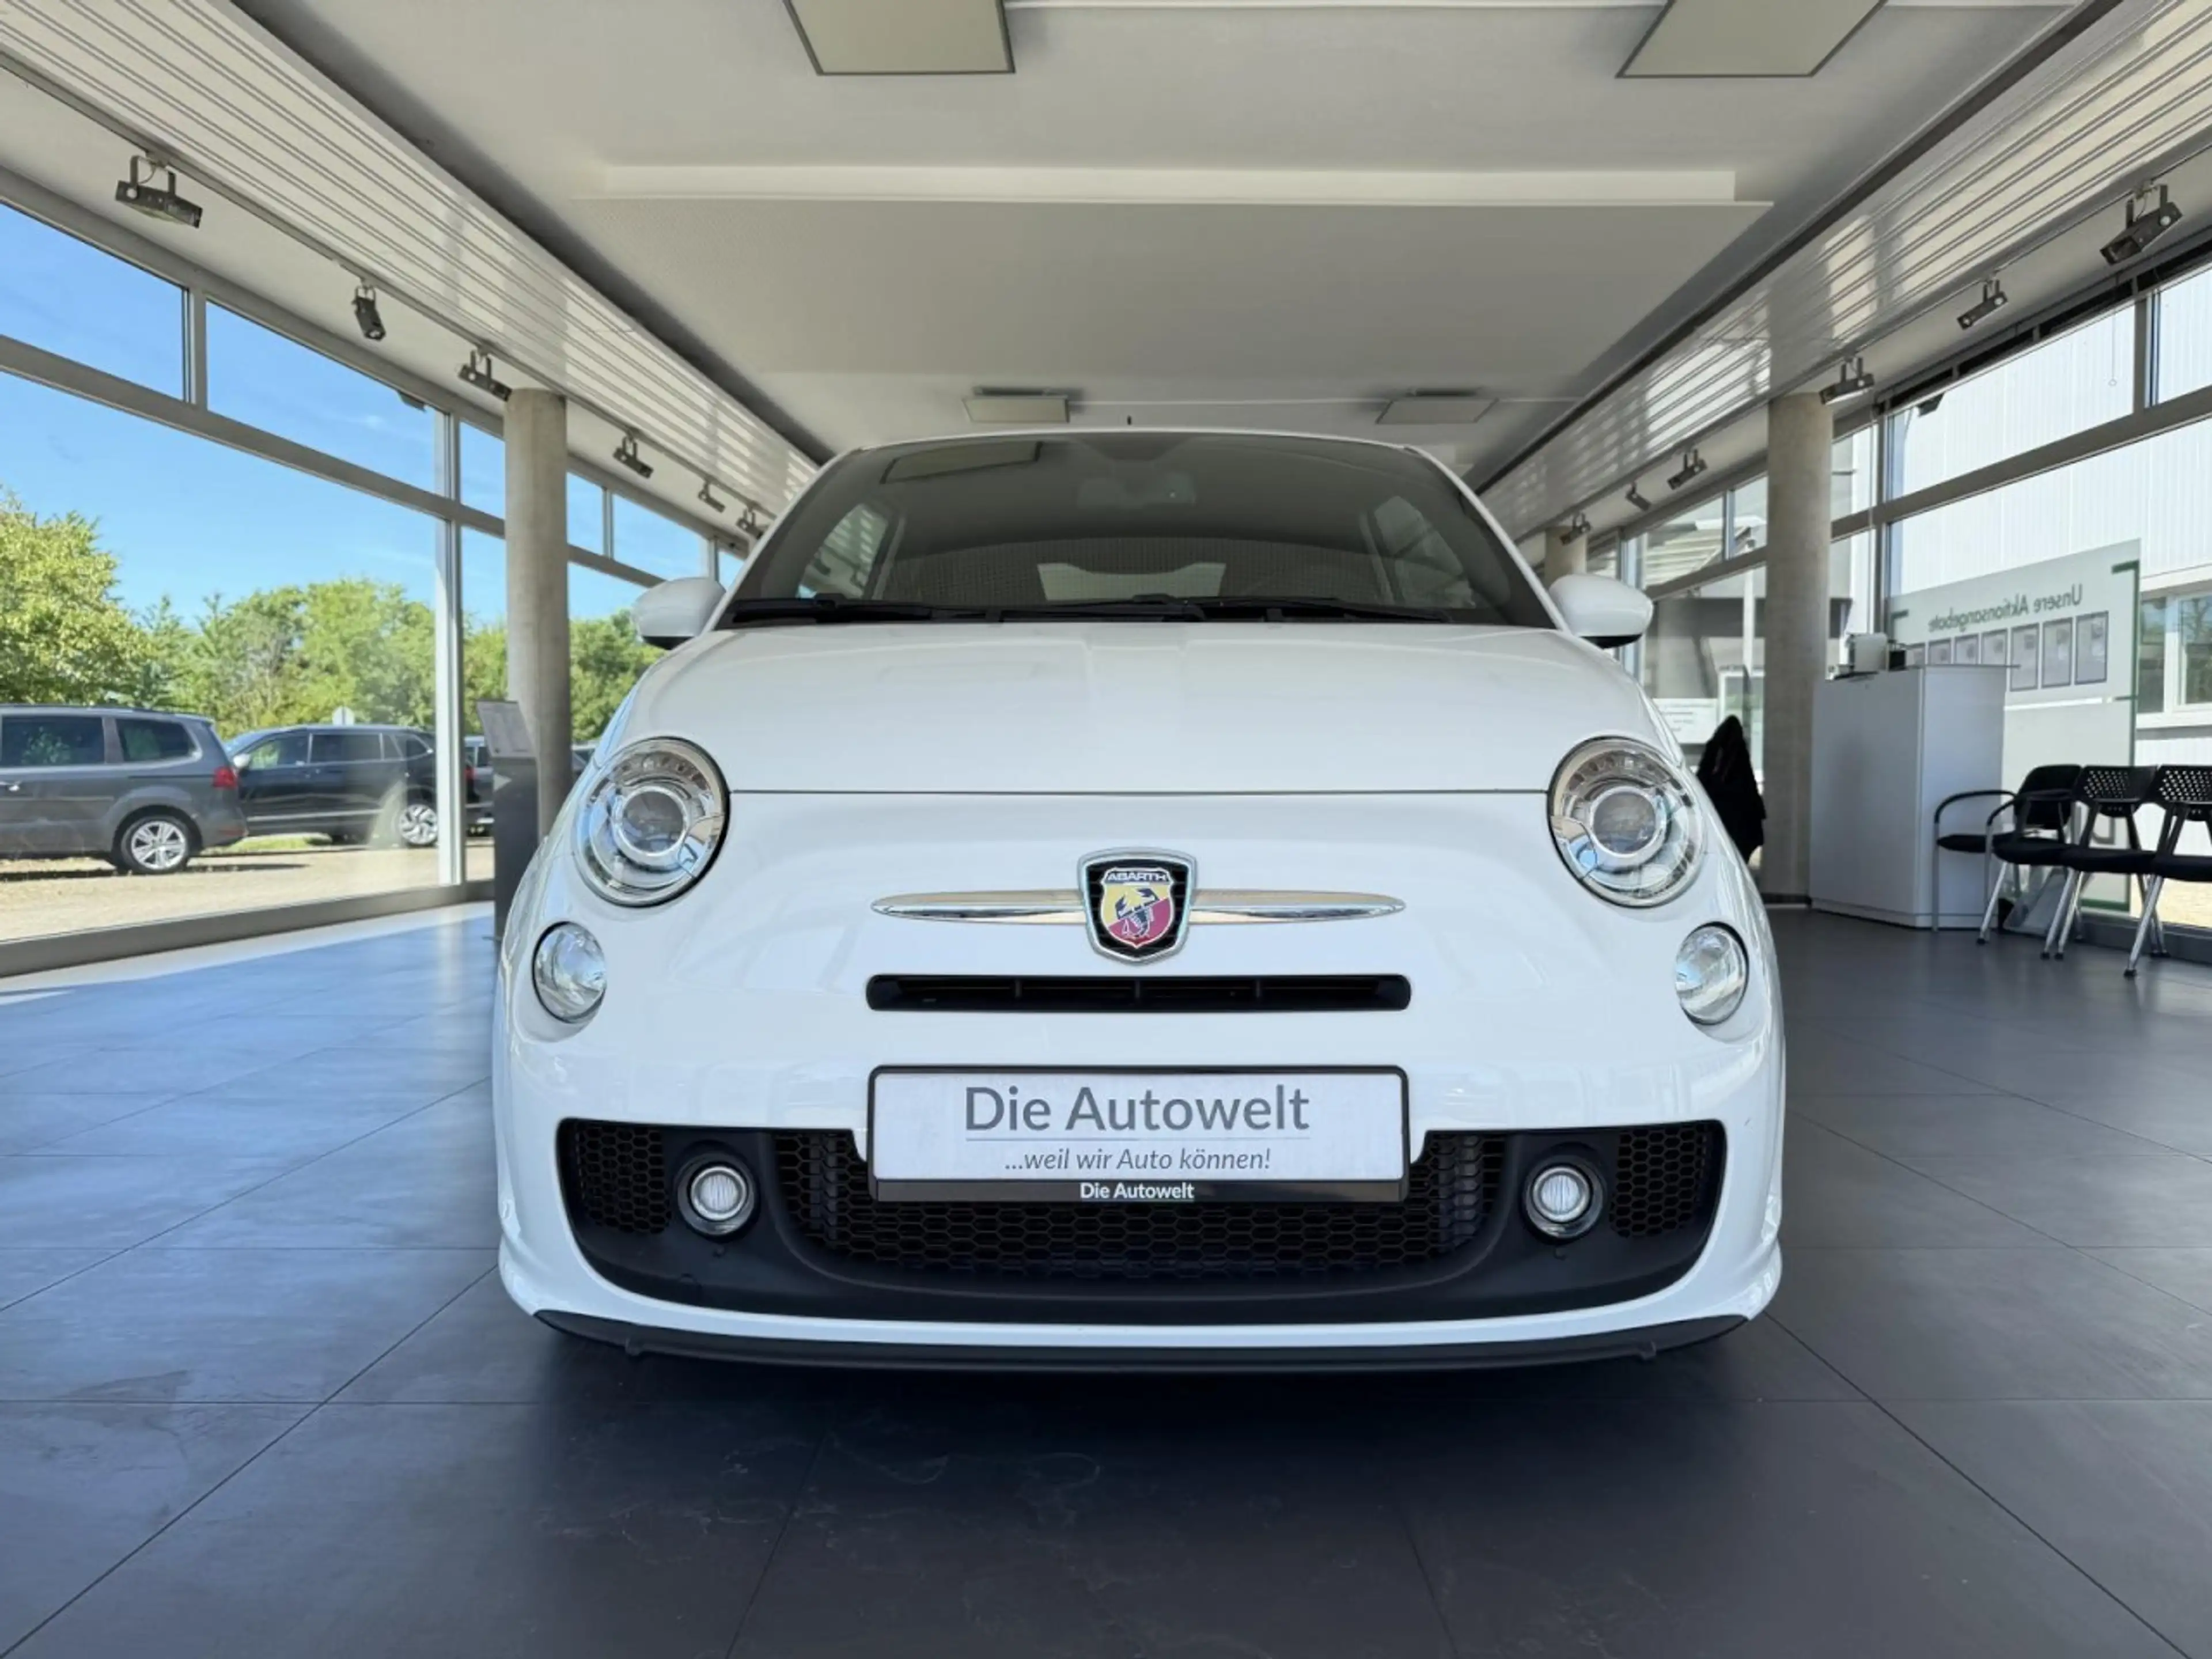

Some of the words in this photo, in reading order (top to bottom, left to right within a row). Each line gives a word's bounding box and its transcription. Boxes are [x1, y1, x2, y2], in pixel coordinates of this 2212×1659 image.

[1107, 872, 1166, 881] ABARTH
[965, 1085, 1051, 1131] Die
[1065, 1084, 1310, 1131] Autowelt
[1005, 1148, 1070, 1170] ...weil
[1076, 1148, 1112, 1170] wir
[1116, 1148, 1172, 1170] Auto
[1179, 1147, 1271, 1170] können!
[1080, 1183, 1110, 1199] Die
[1113, 1181, 1195, 1199] Autowelt
